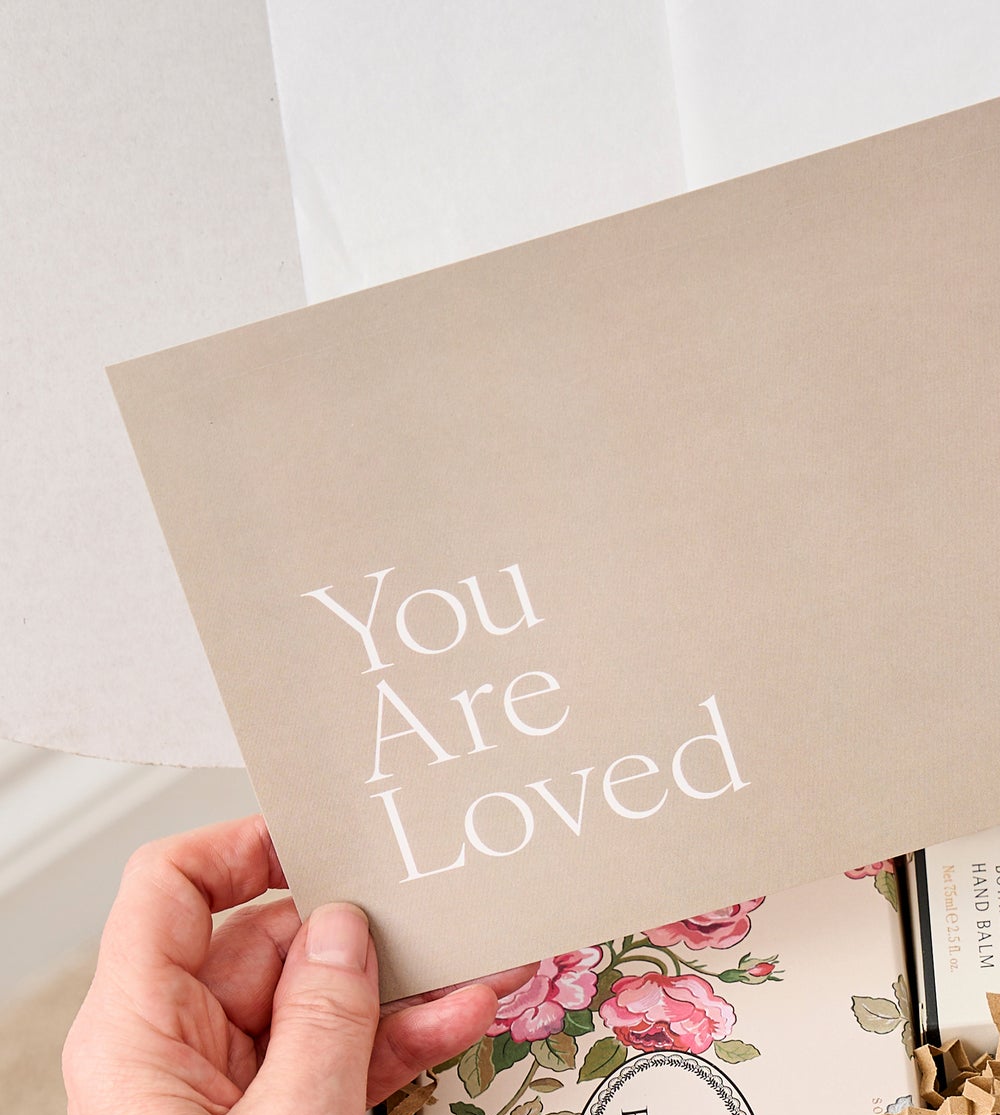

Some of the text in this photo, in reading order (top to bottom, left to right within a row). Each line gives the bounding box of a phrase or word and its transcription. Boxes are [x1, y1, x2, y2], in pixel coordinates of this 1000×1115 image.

[300, 564, 545, 675] You
[364, 671, 570, 784] Are
[370, 694, 752, 884] Loved
[942, 865, 955, 883] Net
[972, 862, 995, 969] HAND BALM
